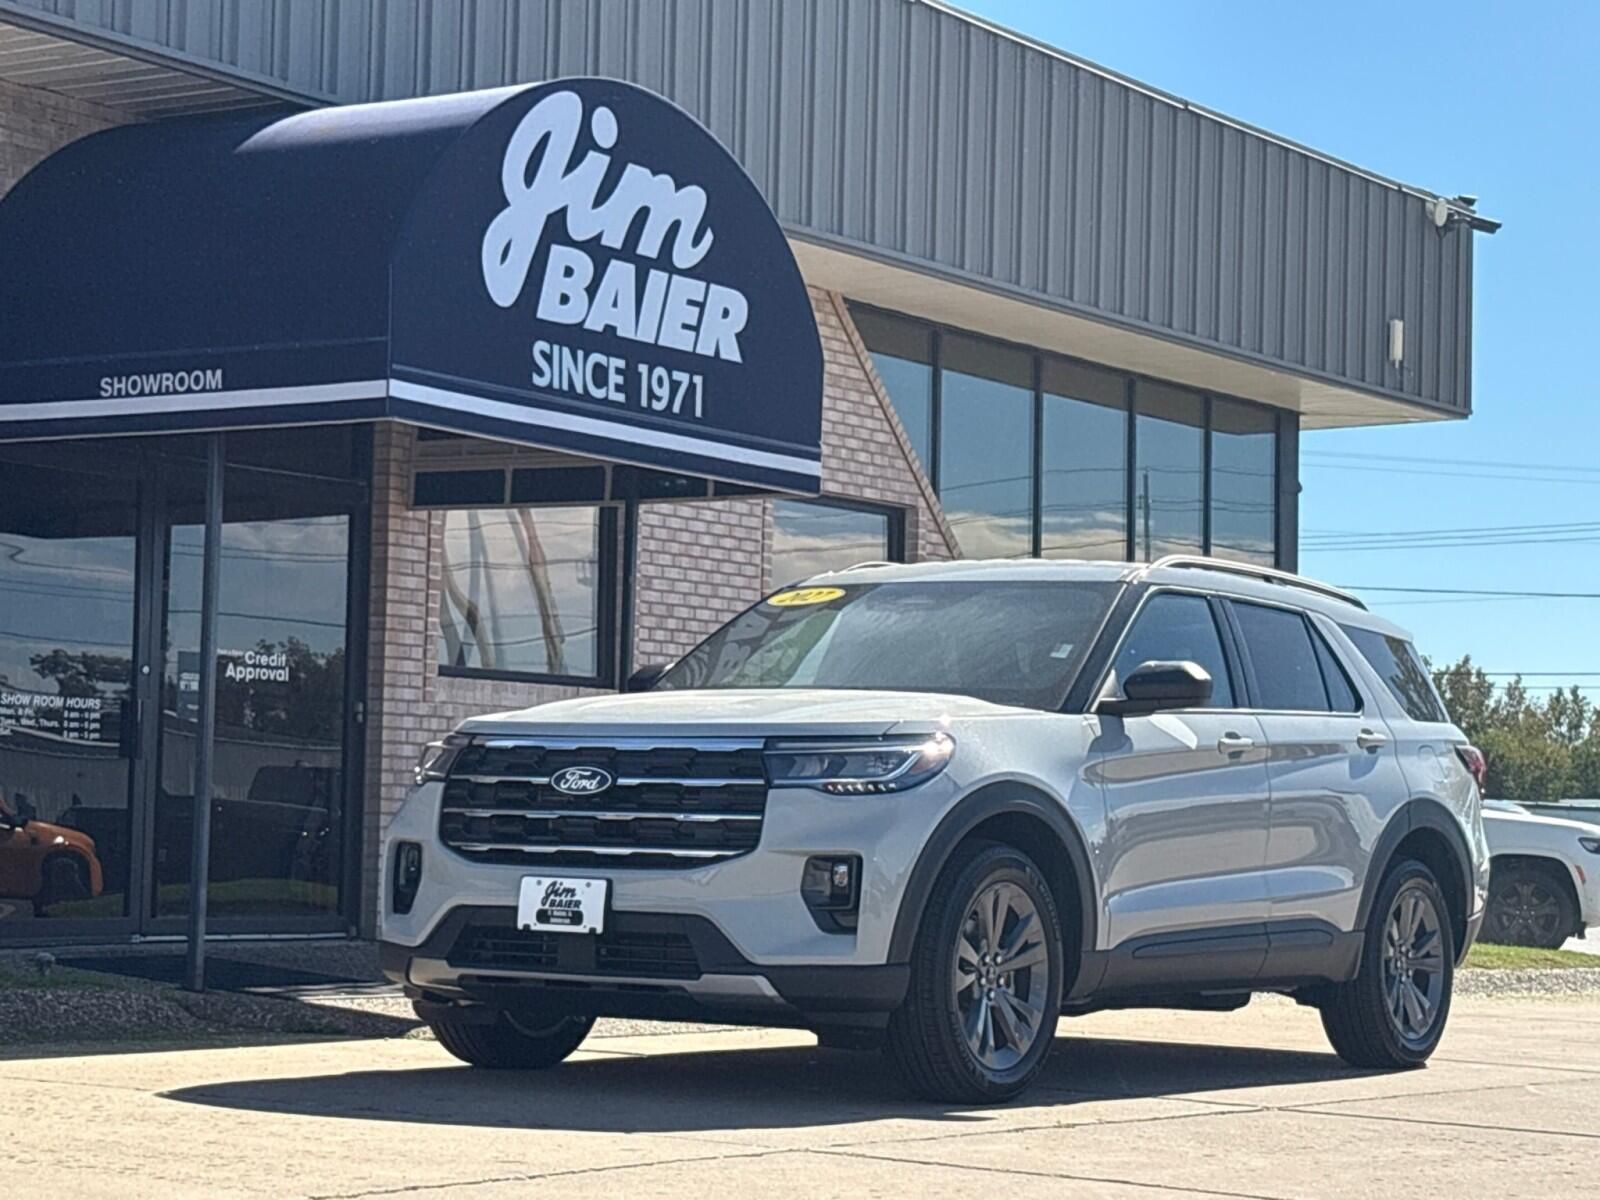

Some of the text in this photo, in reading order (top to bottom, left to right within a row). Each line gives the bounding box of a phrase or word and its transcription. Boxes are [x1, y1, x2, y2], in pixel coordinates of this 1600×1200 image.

[482, 90, 714, 308] Jim
[536, 243, 749, 364] BAIER
[100, 368, 223, 397] SHOWROOM
[531, 340, 703, 418] SINCE 1971
[244, 650, 287, 667] Credit
[225, 661, 290, 683] Approval
[0, 693, 101, 709] SHOW ROOM HOURS
[560, 769, 601, 790] Ford
[541, 880, 577, 906] Jim
[548, 898, 582, 910] BAIER
